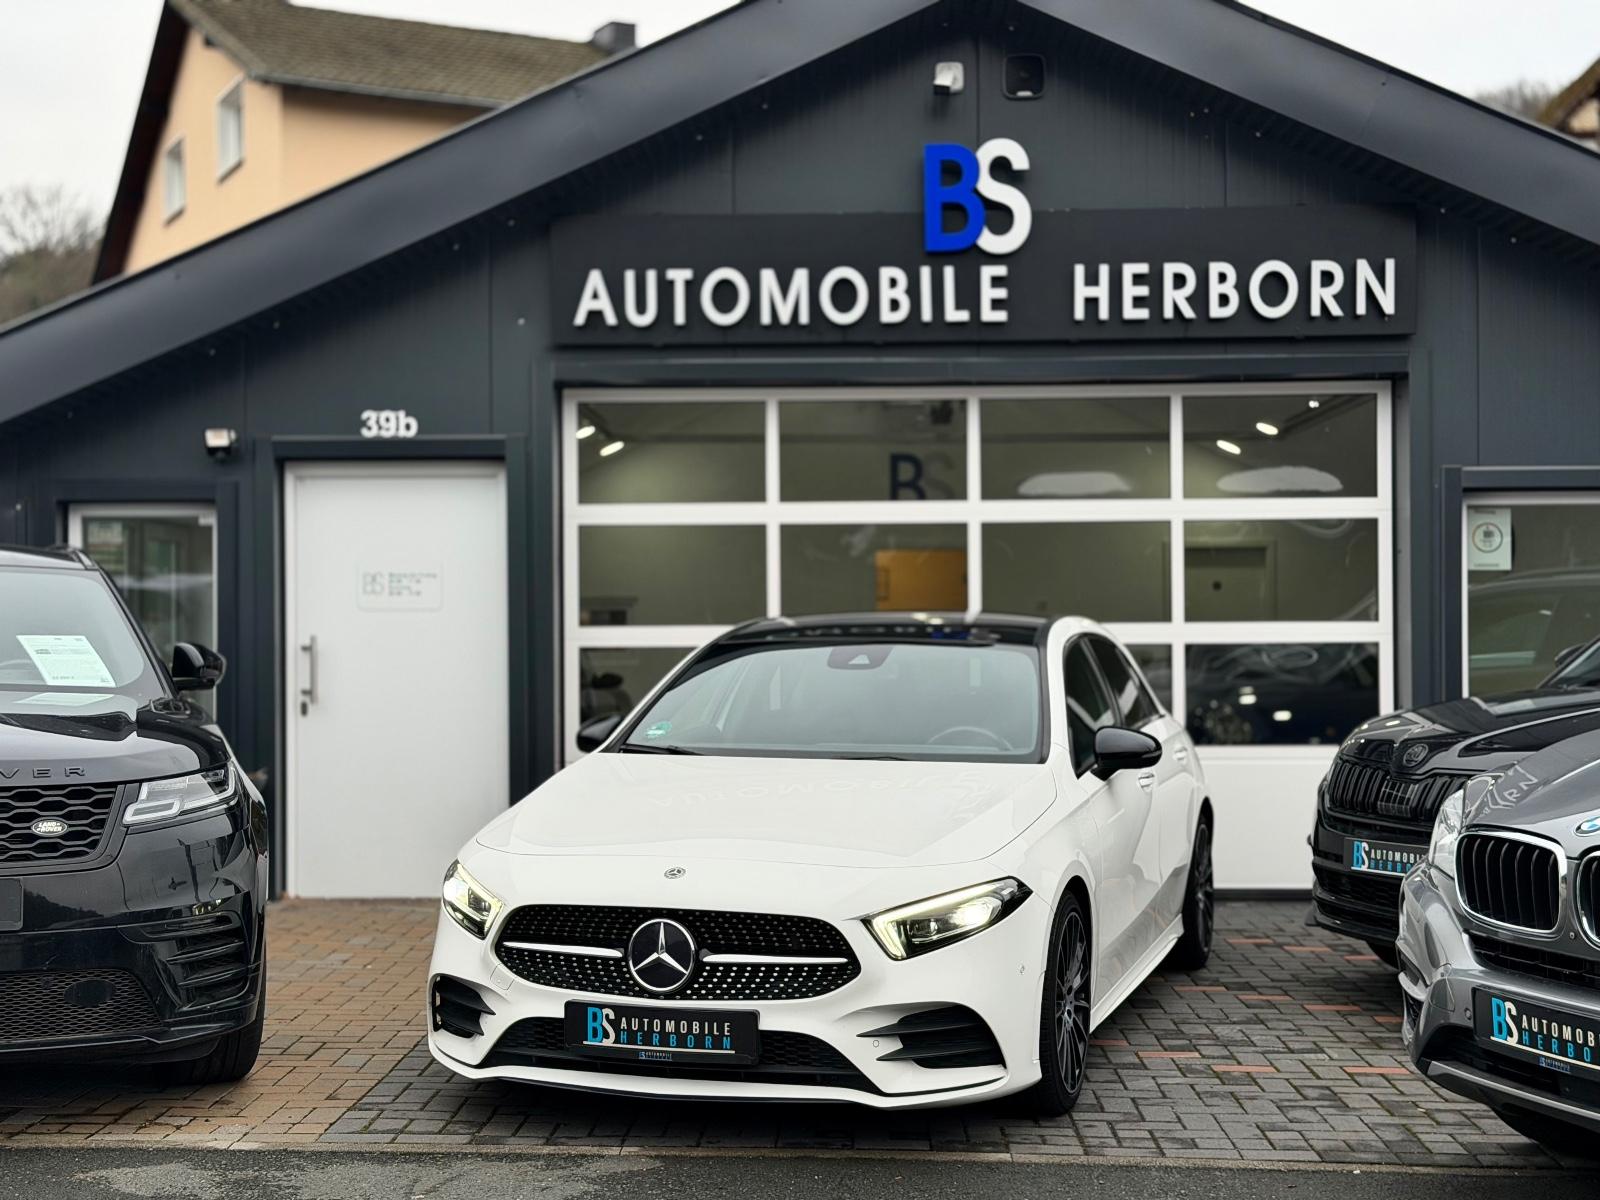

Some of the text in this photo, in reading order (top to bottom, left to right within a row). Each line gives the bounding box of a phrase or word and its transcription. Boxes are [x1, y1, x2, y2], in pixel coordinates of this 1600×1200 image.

[923, 138, 1032, 254] BS
[573, 257, 1397, 328] AUTOMOBILE HERBORN
[360, 409, 419, 438] 39b
[1353, 841, 1369, 869] BS
[1371, 849, 1425, 864] AUTOMOBI
[587, 1007, 616, 1044] BS
[620, 1017, 731, 1036] AUTOMOBILE
[1491, 997, 1518, 1045] BS
[1521, 1014, 1600, 1047] AUTOMOB
[620, 1032, 731, 1050] HERBORN
[1522, 1030, 1591, 1062] HERBO
